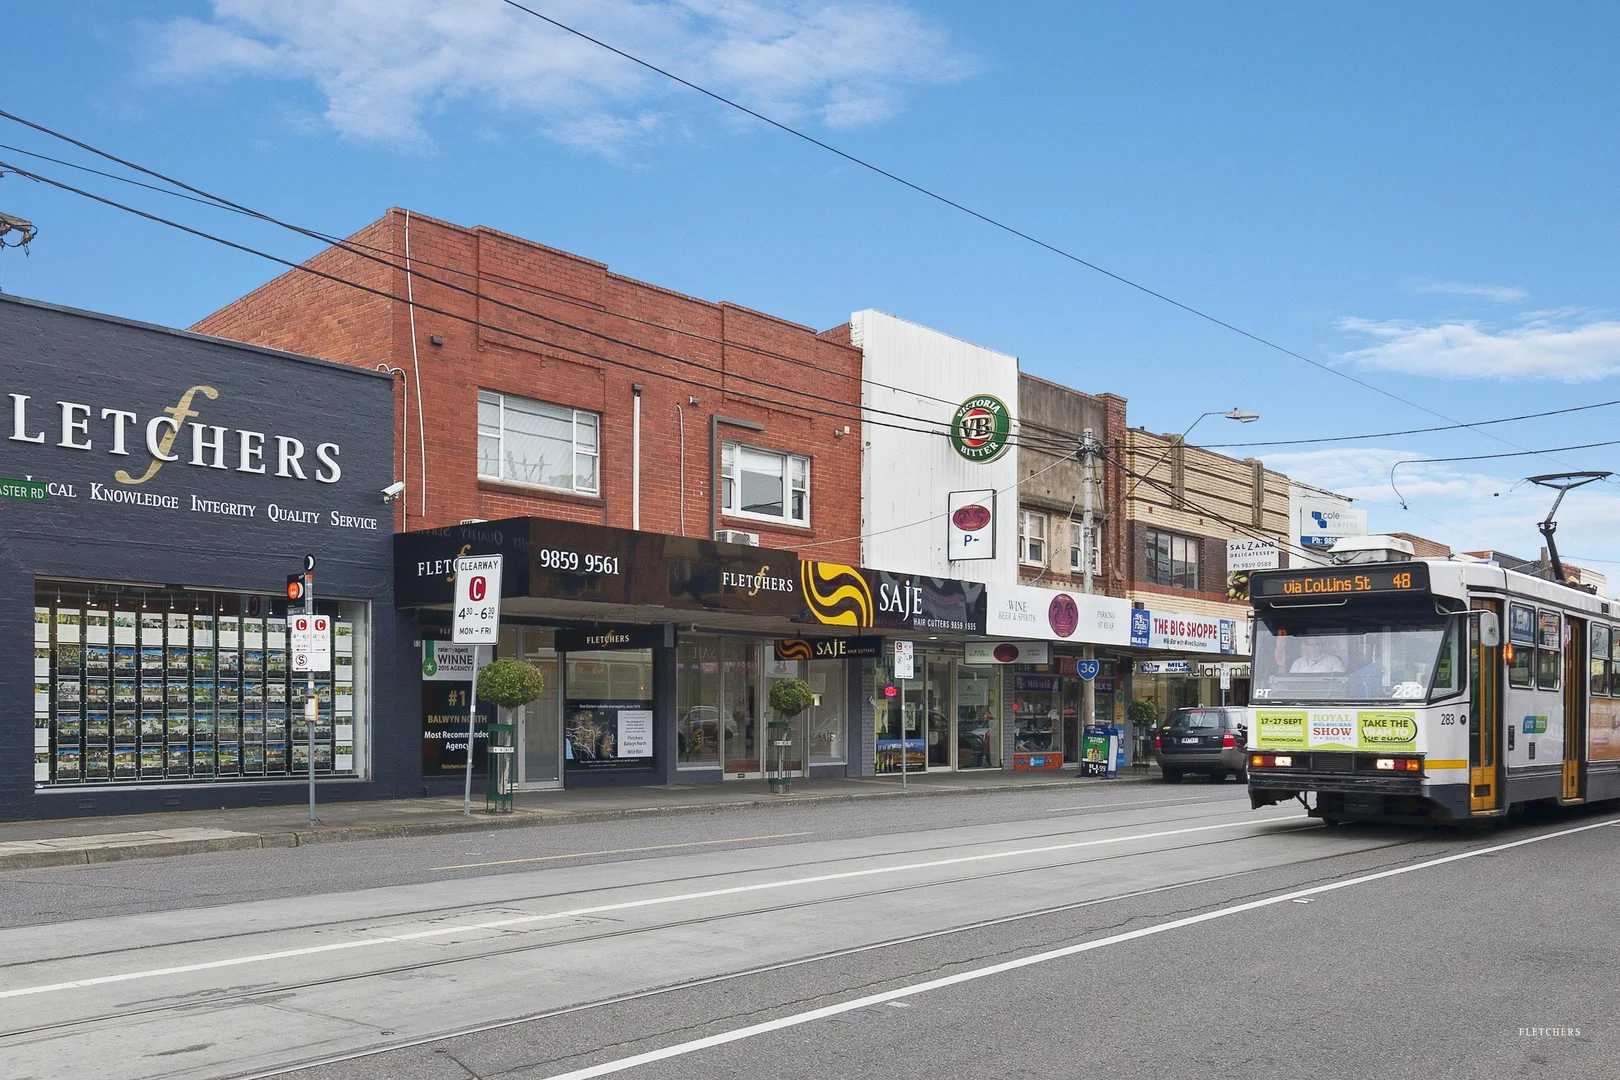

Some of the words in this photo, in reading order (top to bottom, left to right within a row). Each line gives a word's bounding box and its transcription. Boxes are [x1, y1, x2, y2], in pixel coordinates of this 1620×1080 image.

[957, 399, 1001, 417] VICTORIA
[962, 417, 991, 438] VB
[960, 441, 999, 457] BITTER
[31, 487, 44, 499] RD
[90, 482, 179, 509] KNOWLEDGE
[190, 495, 256, 517] INTEGRITY
[267, 504, 320, 524] QUALITY
[330, 511, 377, 530] SERVICE
[1322, 511, 1340, 520] cole
[964, 535, 973, 546] P
[1230, 541, 1274, 551] SALZANO
[460, 561, 499, 571] CLEARWAY
[540, 549, 579, 570] 9859
[585, 554, 619, 575] 9561
[722, 571, 794, 592] FLETCHERS
[1283, 581, 1302, 594] via
[1304, 578, 1352, 594] Collins
[1354, 575, 1371, 590] St
[1392, 573, 1411, 589] 48
[1008, 600, 1027, 612] WINE
[999, 611, 1011, 620] BEER
[1018, 613, 1036, 622] SPIRITS
[1097, 610, 1115, 620] PARKING
[913, 618, 926, 627] HAIR
[927, 619, 950, 629] CUTTERS
[1103, 622, 1114, 630] REAR
[1153, 617, 1168, 634] THE
[1170, 620, 1185, 637] BIG
[1186, 621, 1217, 639] SHOPPE
[459, 627, 473, 635] MON
[586, 634, 630, 644] FLETCHERS
[438, 654, 480, 665] WINNE
[1081, 663, 1095, 673] 36
[448, 690, 466, 706] #1
[1255, 688, 1271, 698] PT
[428, 715, 460, 724] BALWYN
[1362, 719, 1387, 728] TAKE
[1390, 720, 1409, 728] THE
[1441, 713, 1455, 725] 283
[424, 731, 442, 739] Most
[1313, 728, 1352, 736] SHOW
[1363, 727, 1392, 736] TRAM
[1395, 728, 1409, 736] TO
